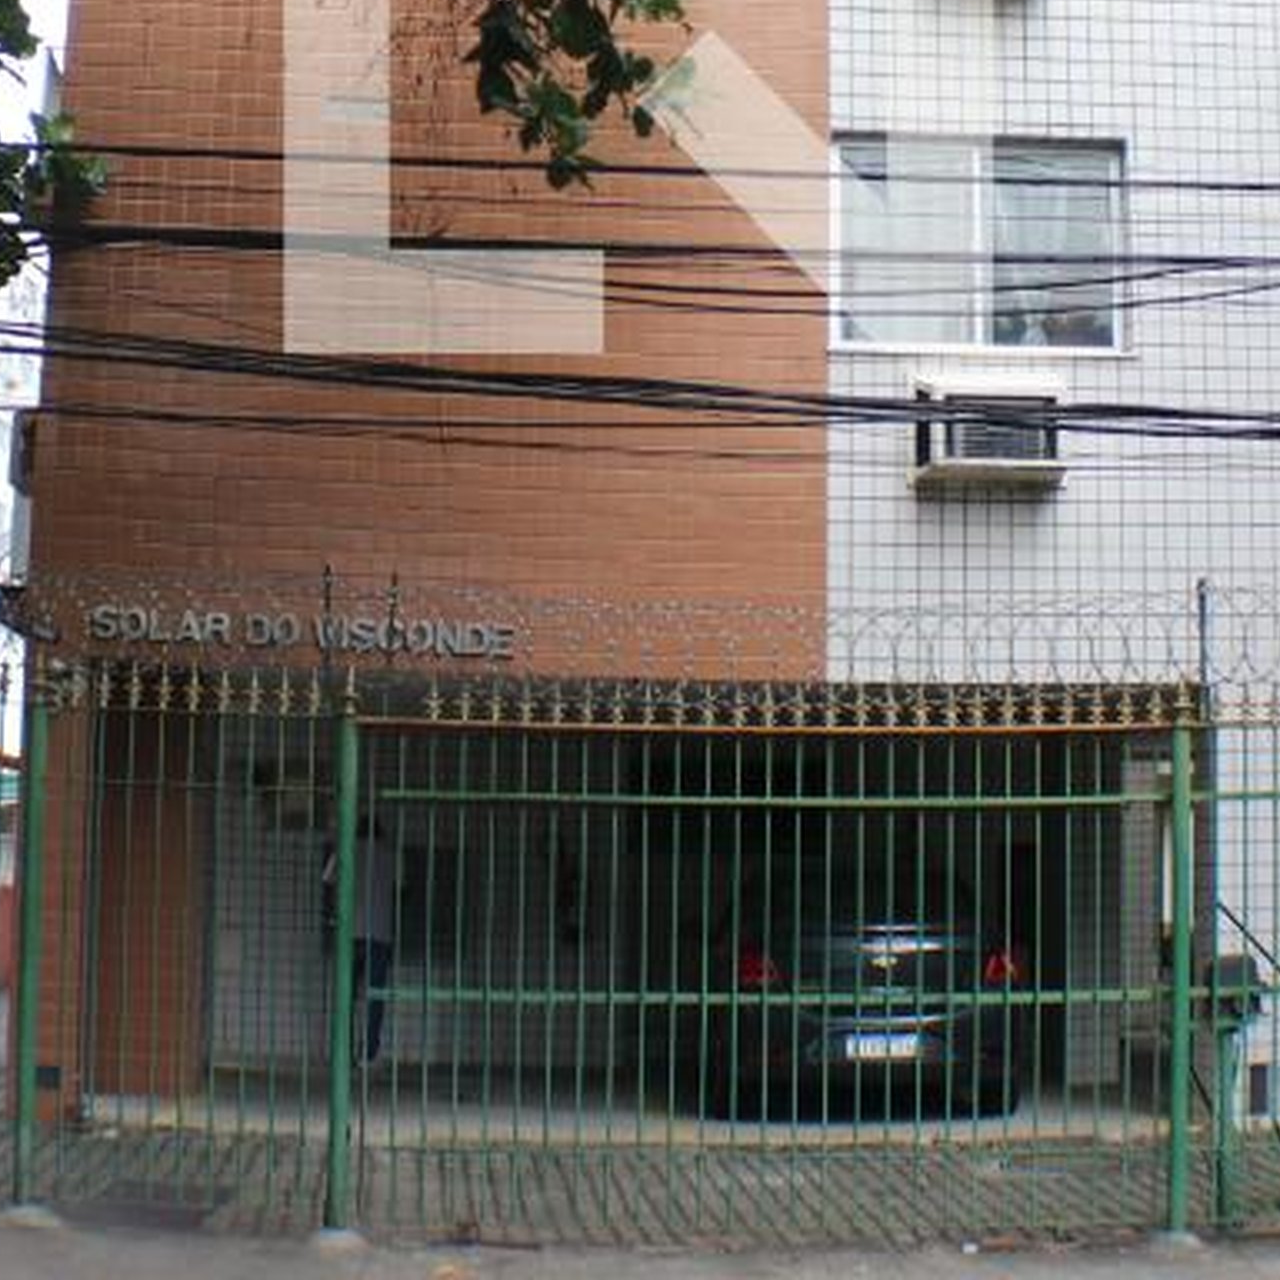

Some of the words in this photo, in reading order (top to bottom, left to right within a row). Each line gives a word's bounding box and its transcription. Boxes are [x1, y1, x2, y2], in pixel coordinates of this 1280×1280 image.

[92, 605, 231, 641] SOLAR
[246, 612, 301, 644] DO
[314, 617, 514, 658] VISCONDE
